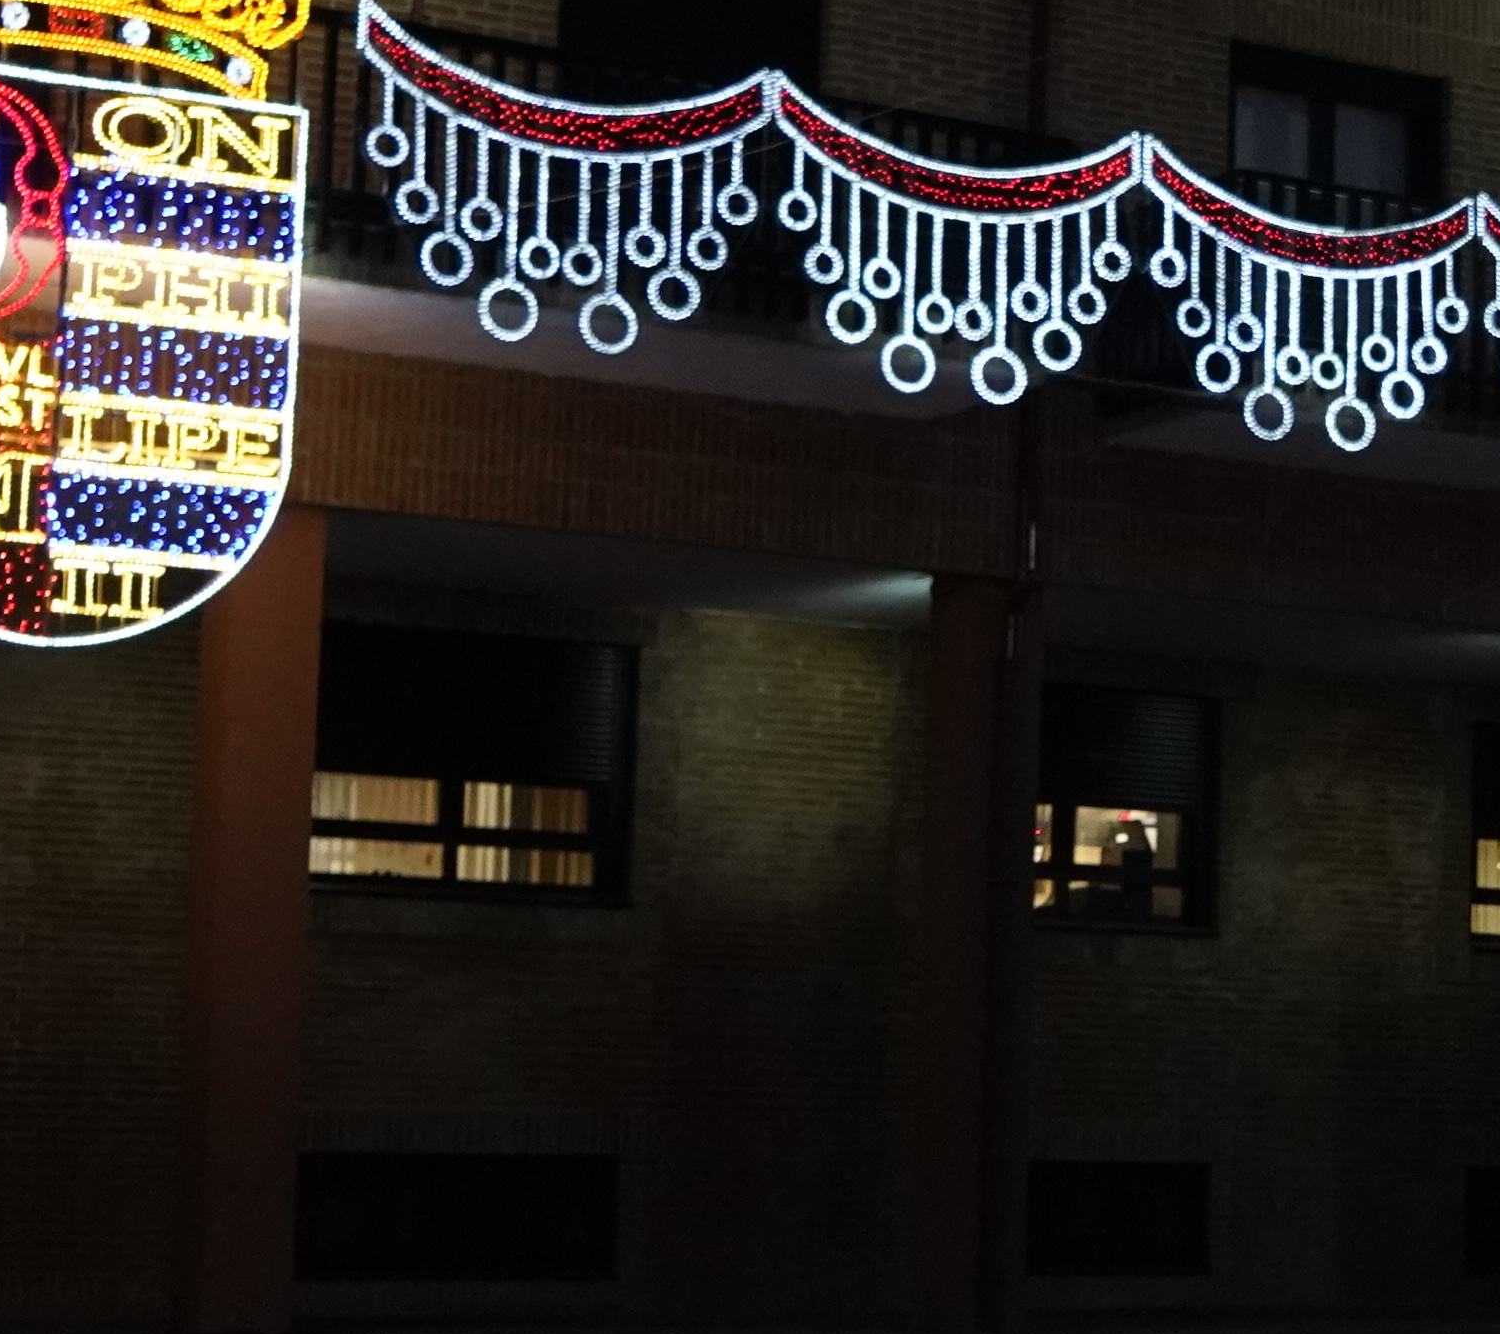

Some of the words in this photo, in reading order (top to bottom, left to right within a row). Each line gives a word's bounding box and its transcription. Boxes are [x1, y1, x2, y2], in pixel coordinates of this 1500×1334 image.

[93, 97, 291, 178] ON
[70, 254, 289, 323] PHI
[61, 406, 280, 477] LIPE
[52, 559, 166, 618] II
